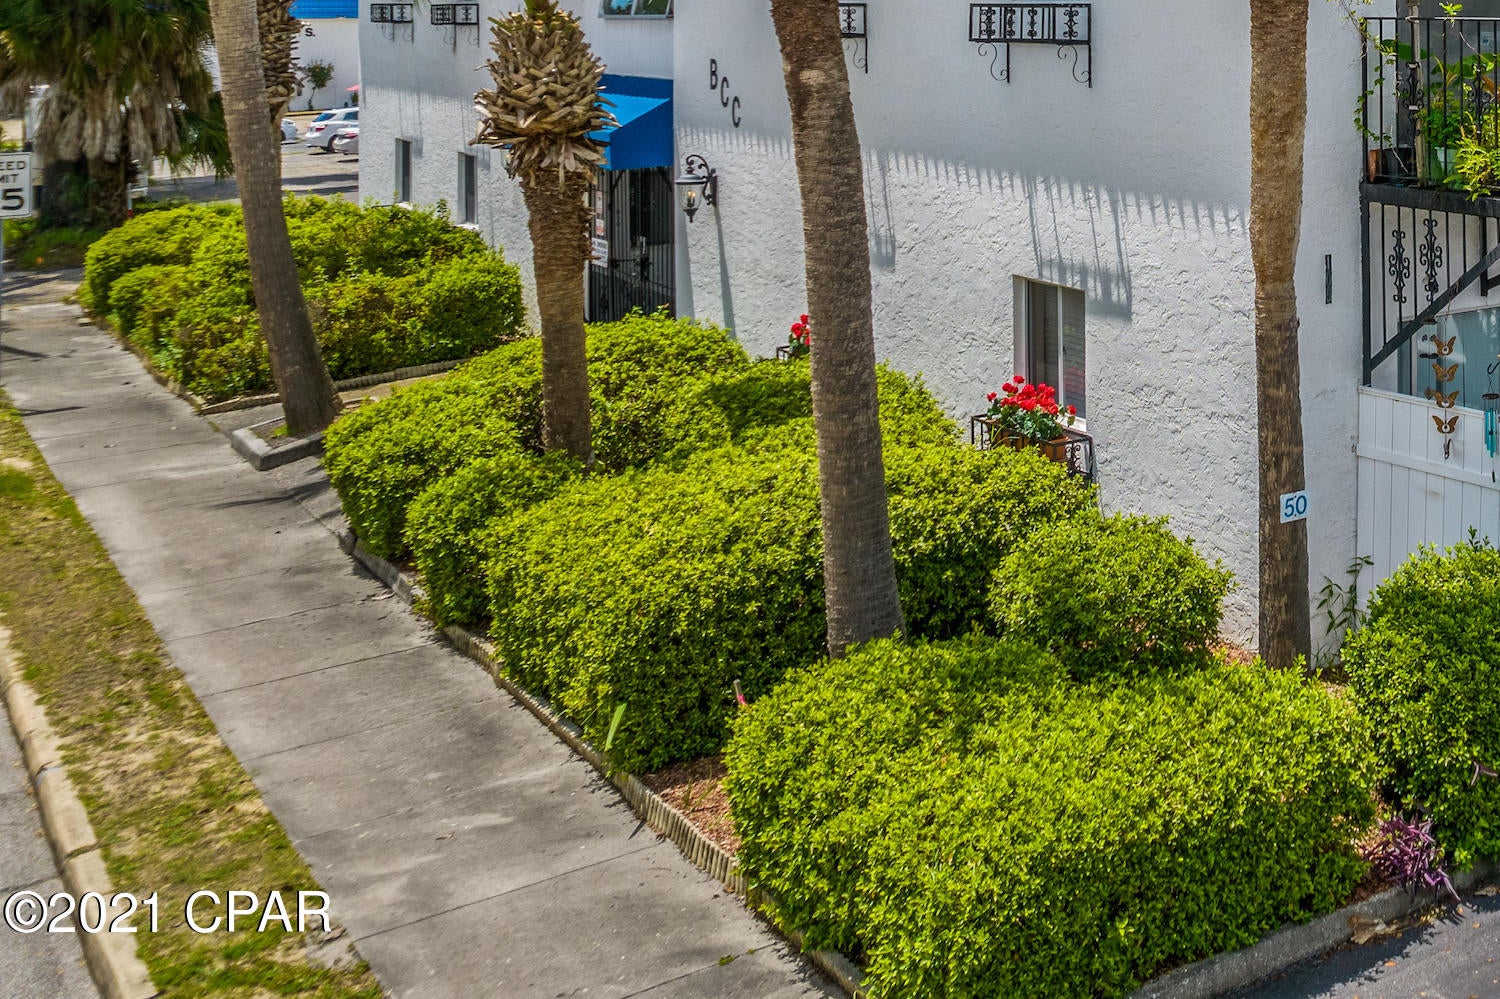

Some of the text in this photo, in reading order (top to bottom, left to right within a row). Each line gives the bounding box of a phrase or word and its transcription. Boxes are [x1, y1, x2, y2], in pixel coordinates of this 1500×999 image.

[709, 58, 741, 129] BCC
[0, 160, 26, 171] EED
[0, 173, 20, 184] MIT
[1, 187, 24, 210] 5
[1284, 494, 1308, 518] 50
